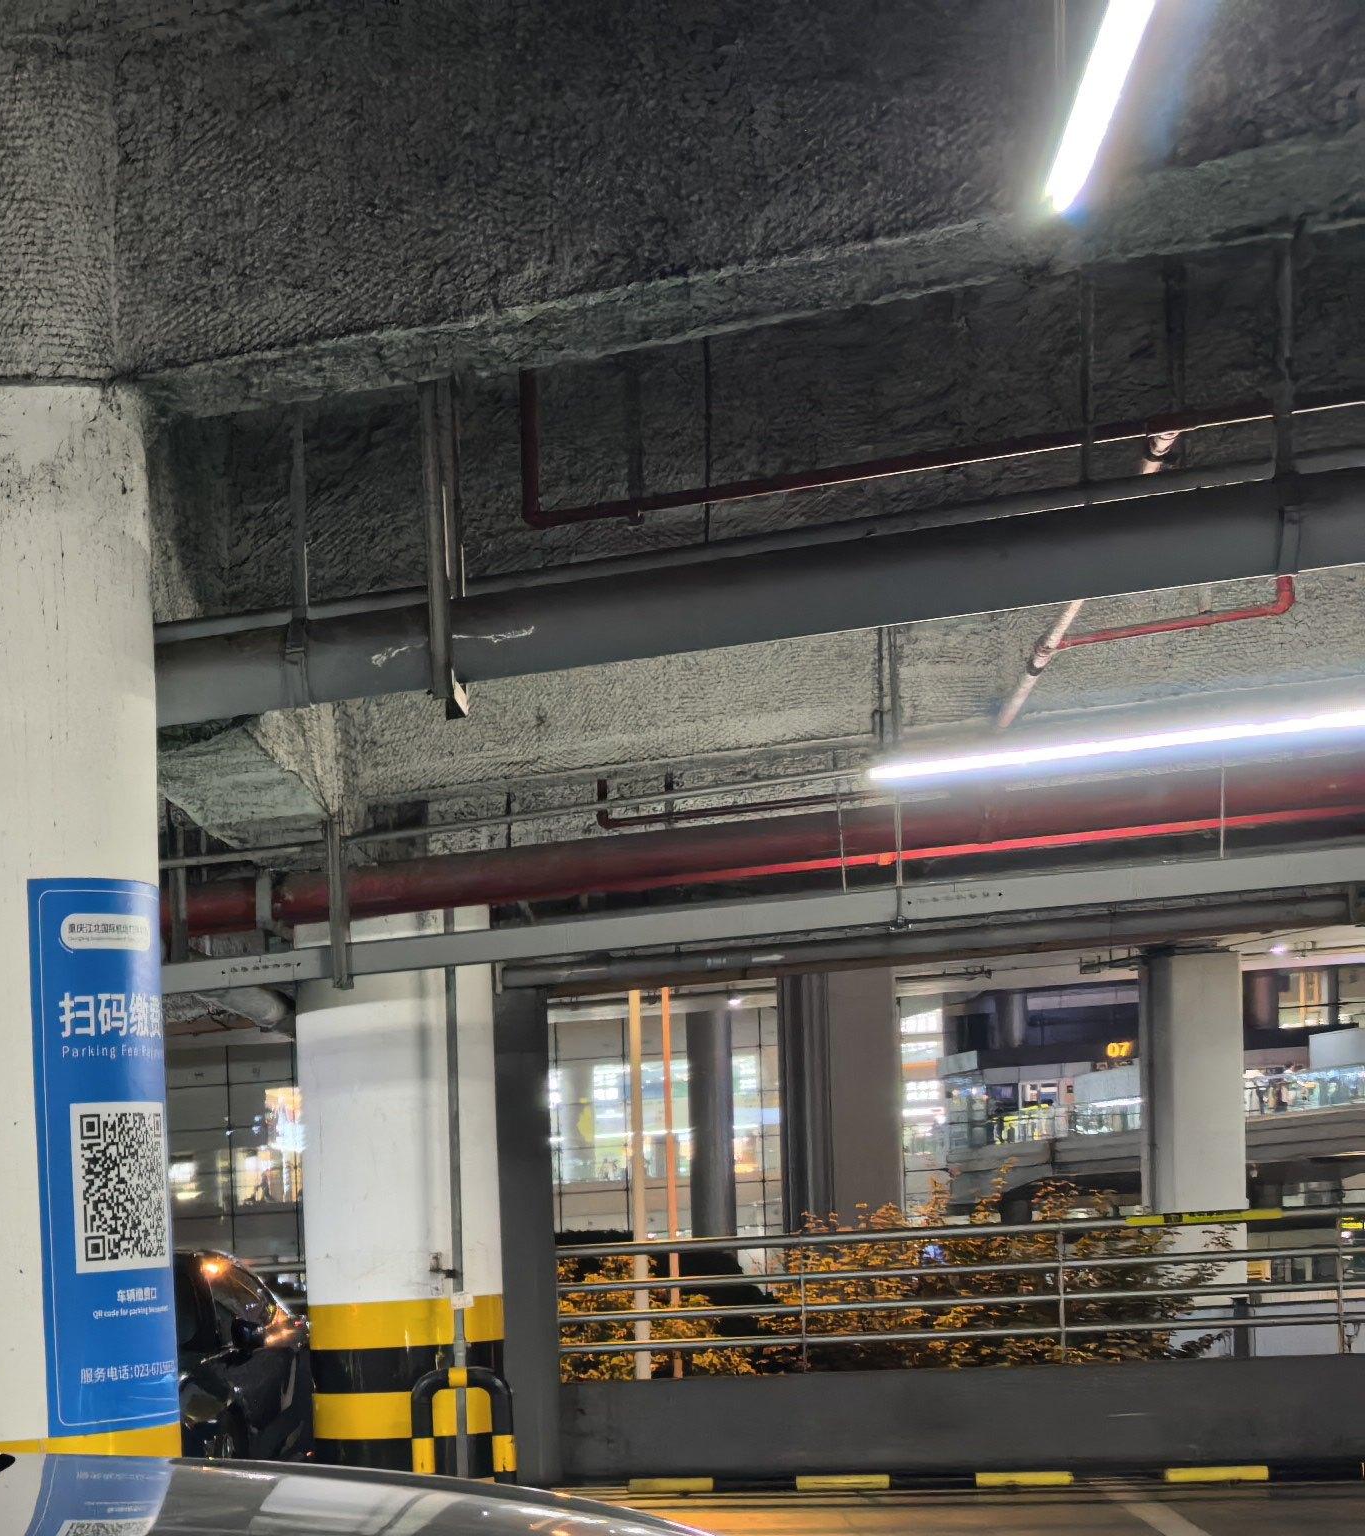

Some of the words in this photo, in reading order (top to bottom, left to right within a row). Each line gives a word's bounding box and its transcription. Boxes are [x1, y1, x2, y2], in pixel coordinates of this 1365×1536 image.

[59, 992, 163, 1040] 扫码缴费
[62, 1045, 116, 1059] Parking
[1107, 1042, 1133, 1057] 07
